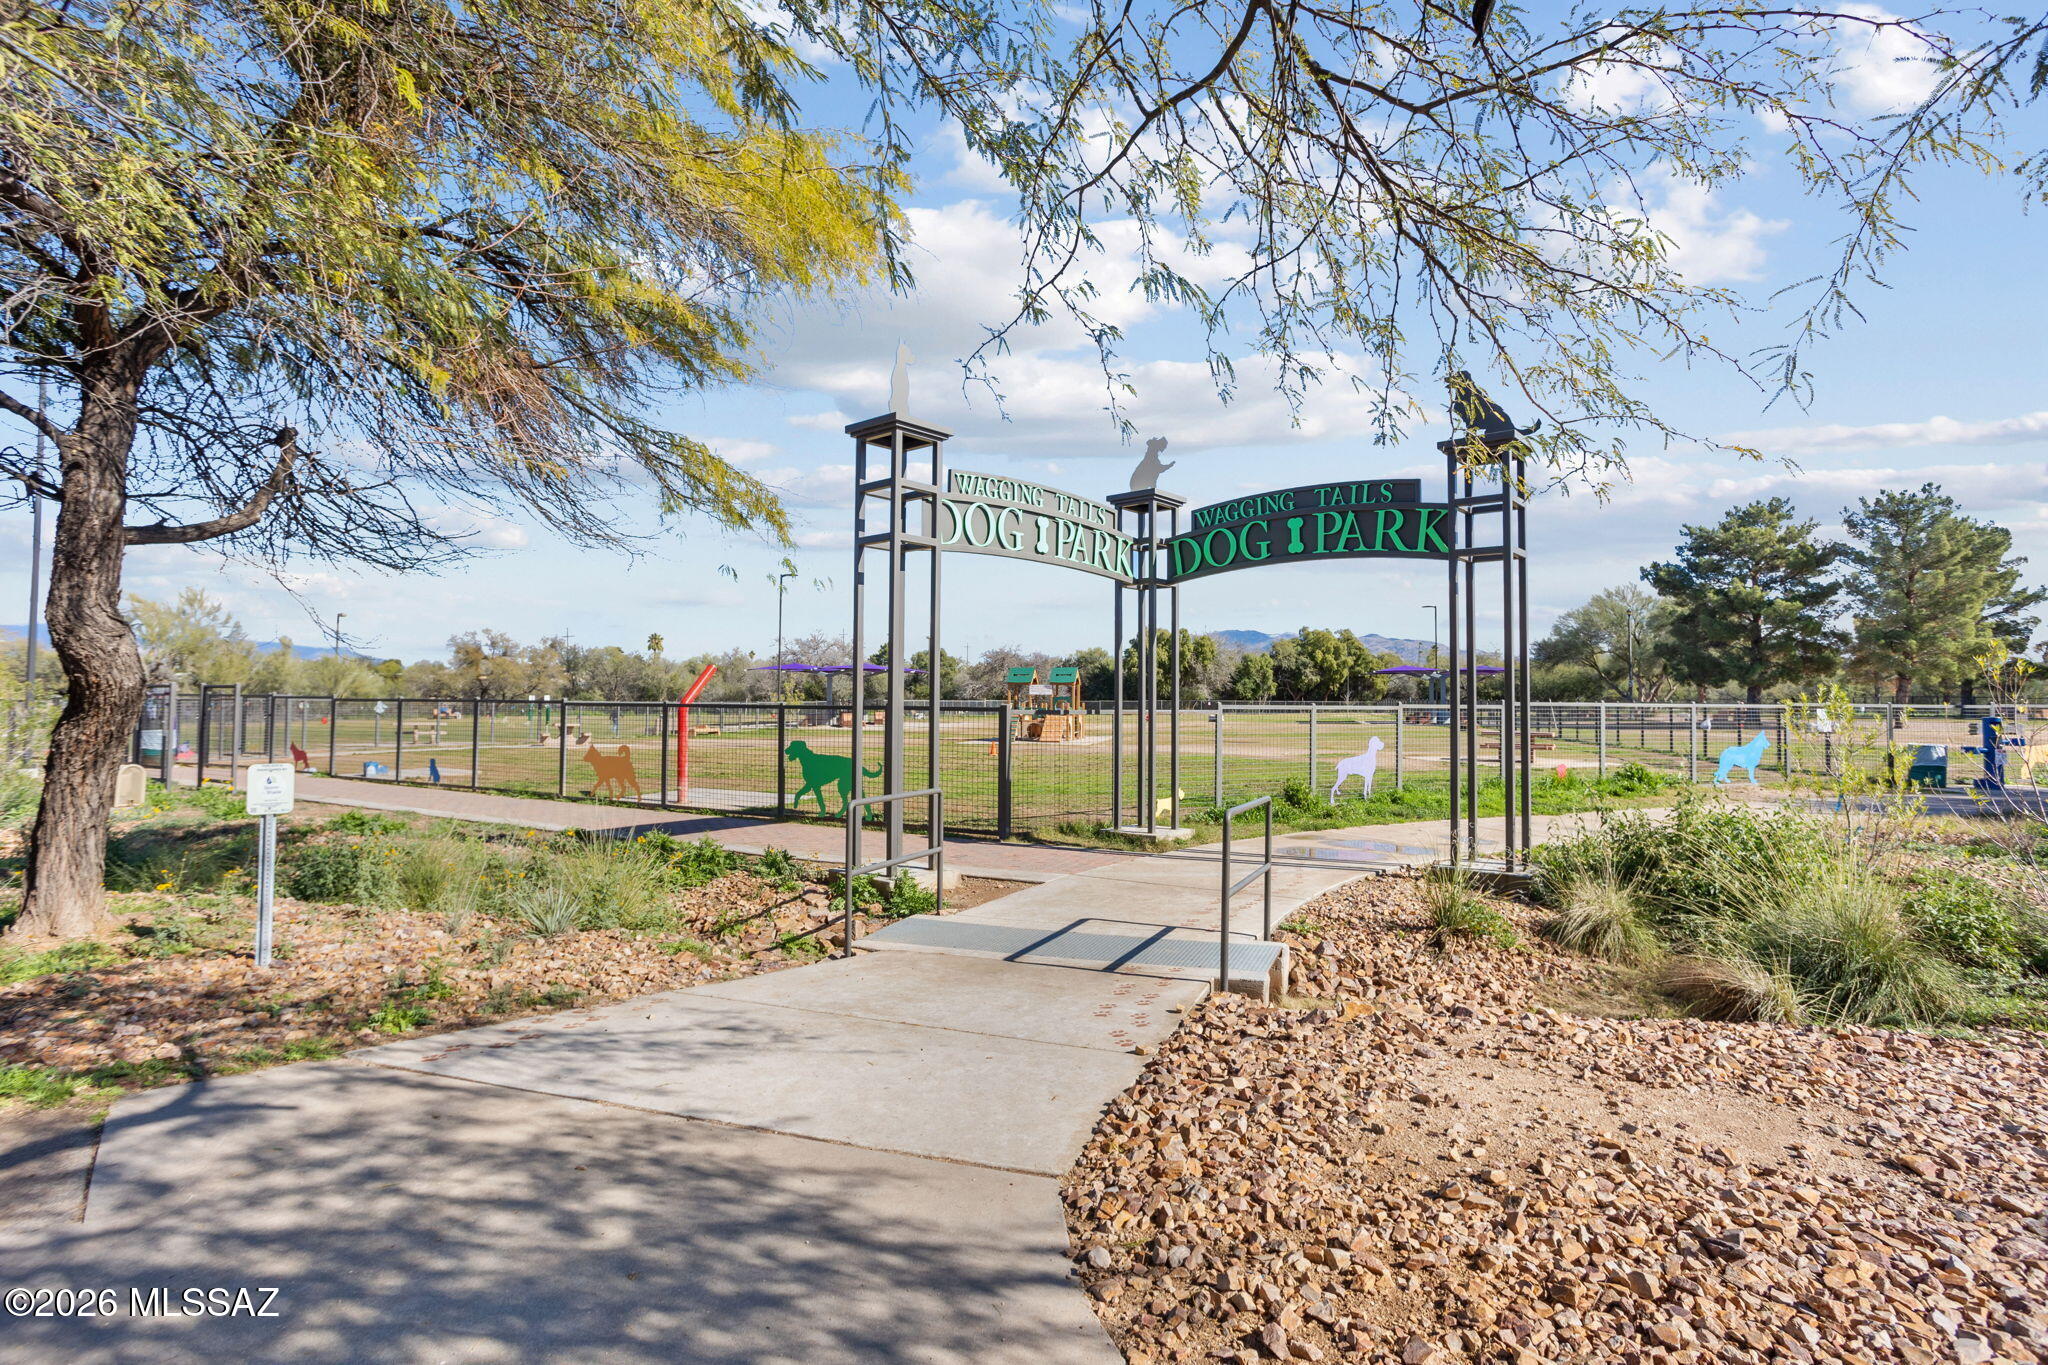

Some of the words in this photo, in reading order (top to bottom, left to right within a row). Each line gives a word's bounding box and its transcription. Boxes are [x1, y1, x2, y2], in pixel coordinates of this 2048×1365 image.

[954, 472, 1045, 508] WAGGING
[1055, 493, 1107, 526] TAILS
[1195, 491, 1296, 528] WAGGING
[1314, 482, 1393, 508] TAILS
[1054, 517, 1134, 578] PARK
[1169, 520, 1272, 578] DOG
[1312, 508, 1449, 554] PARK
